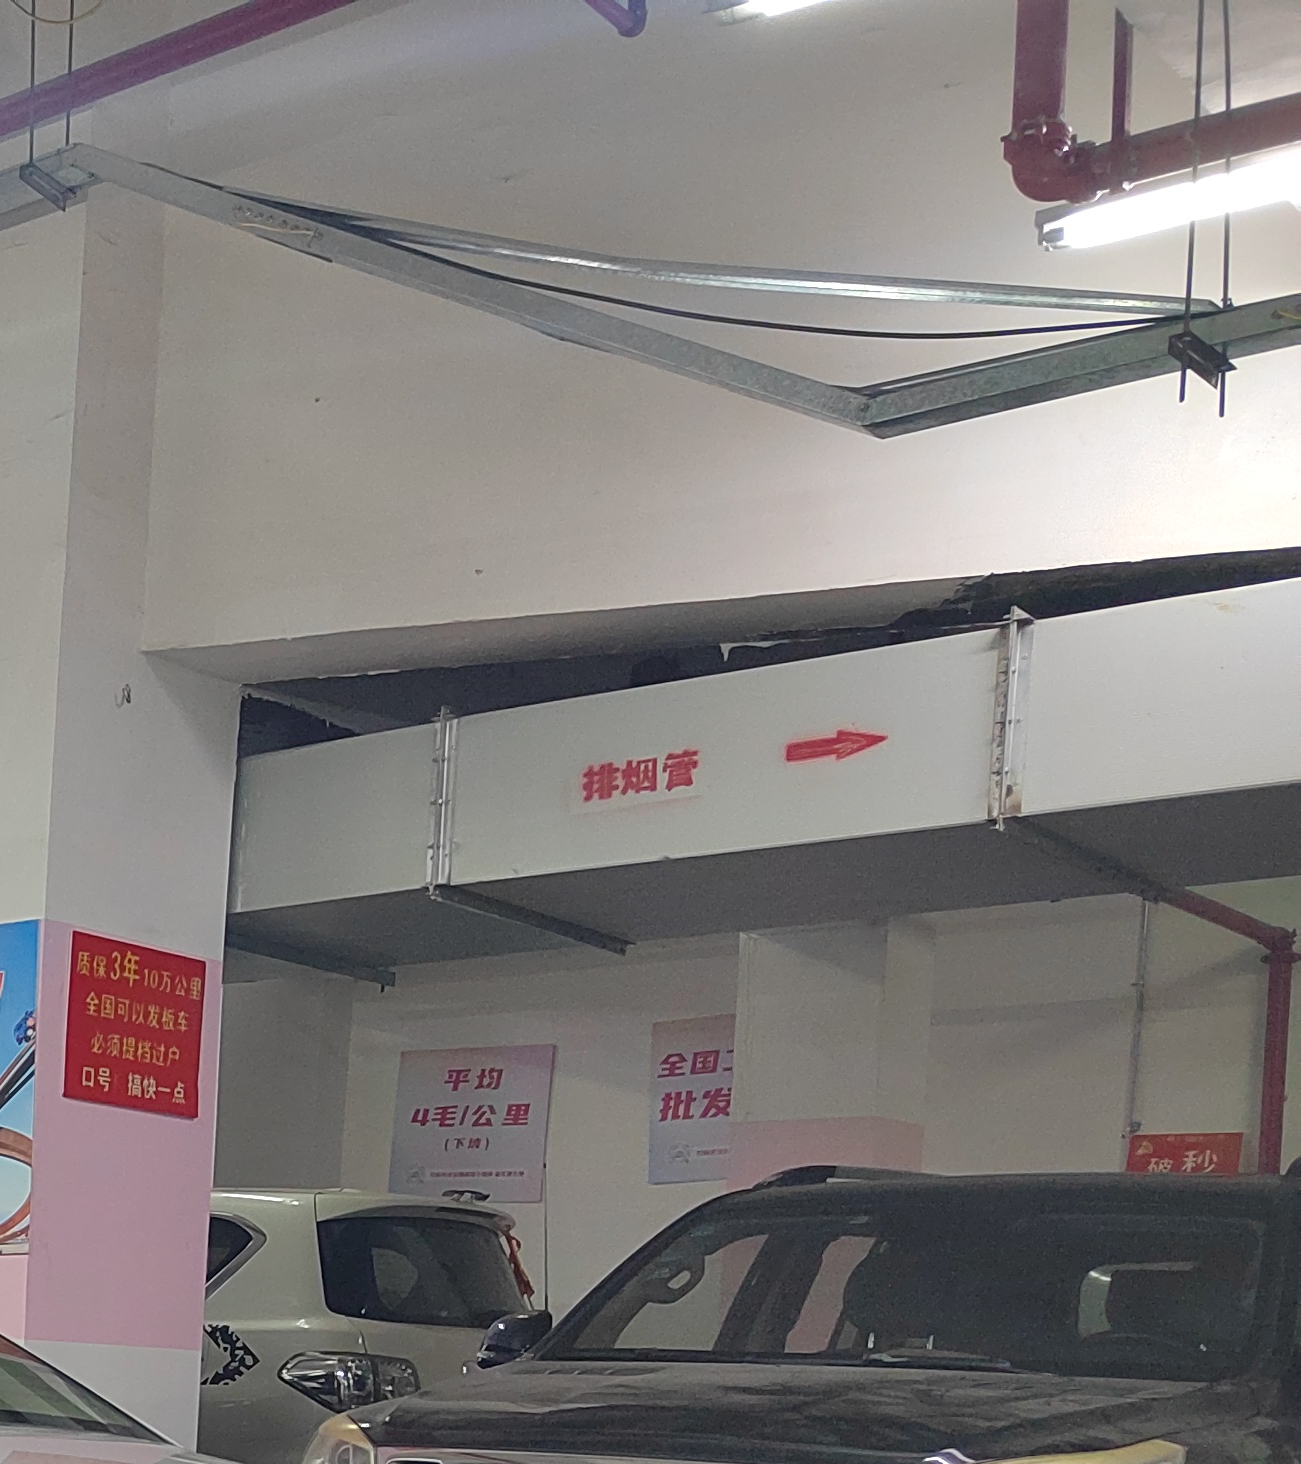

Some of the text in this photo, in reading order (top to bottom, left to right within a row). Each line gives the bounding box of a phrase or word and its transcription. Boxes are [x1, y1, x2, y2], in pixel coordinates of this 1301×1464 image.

[582, 749, 700, 802] 排烟管
[85, 991, 190, 1033] 全国可以发板车
[91, 1032, 180, 1067] 必须提档过户
[82, 1066, 186, 1104] 口号 搞快一点
[444, 1067, 504, 1092] 平均
[410, 1103, 531, 1128] 4毛/公里
[659, 1087, 732, 1122] 批发
